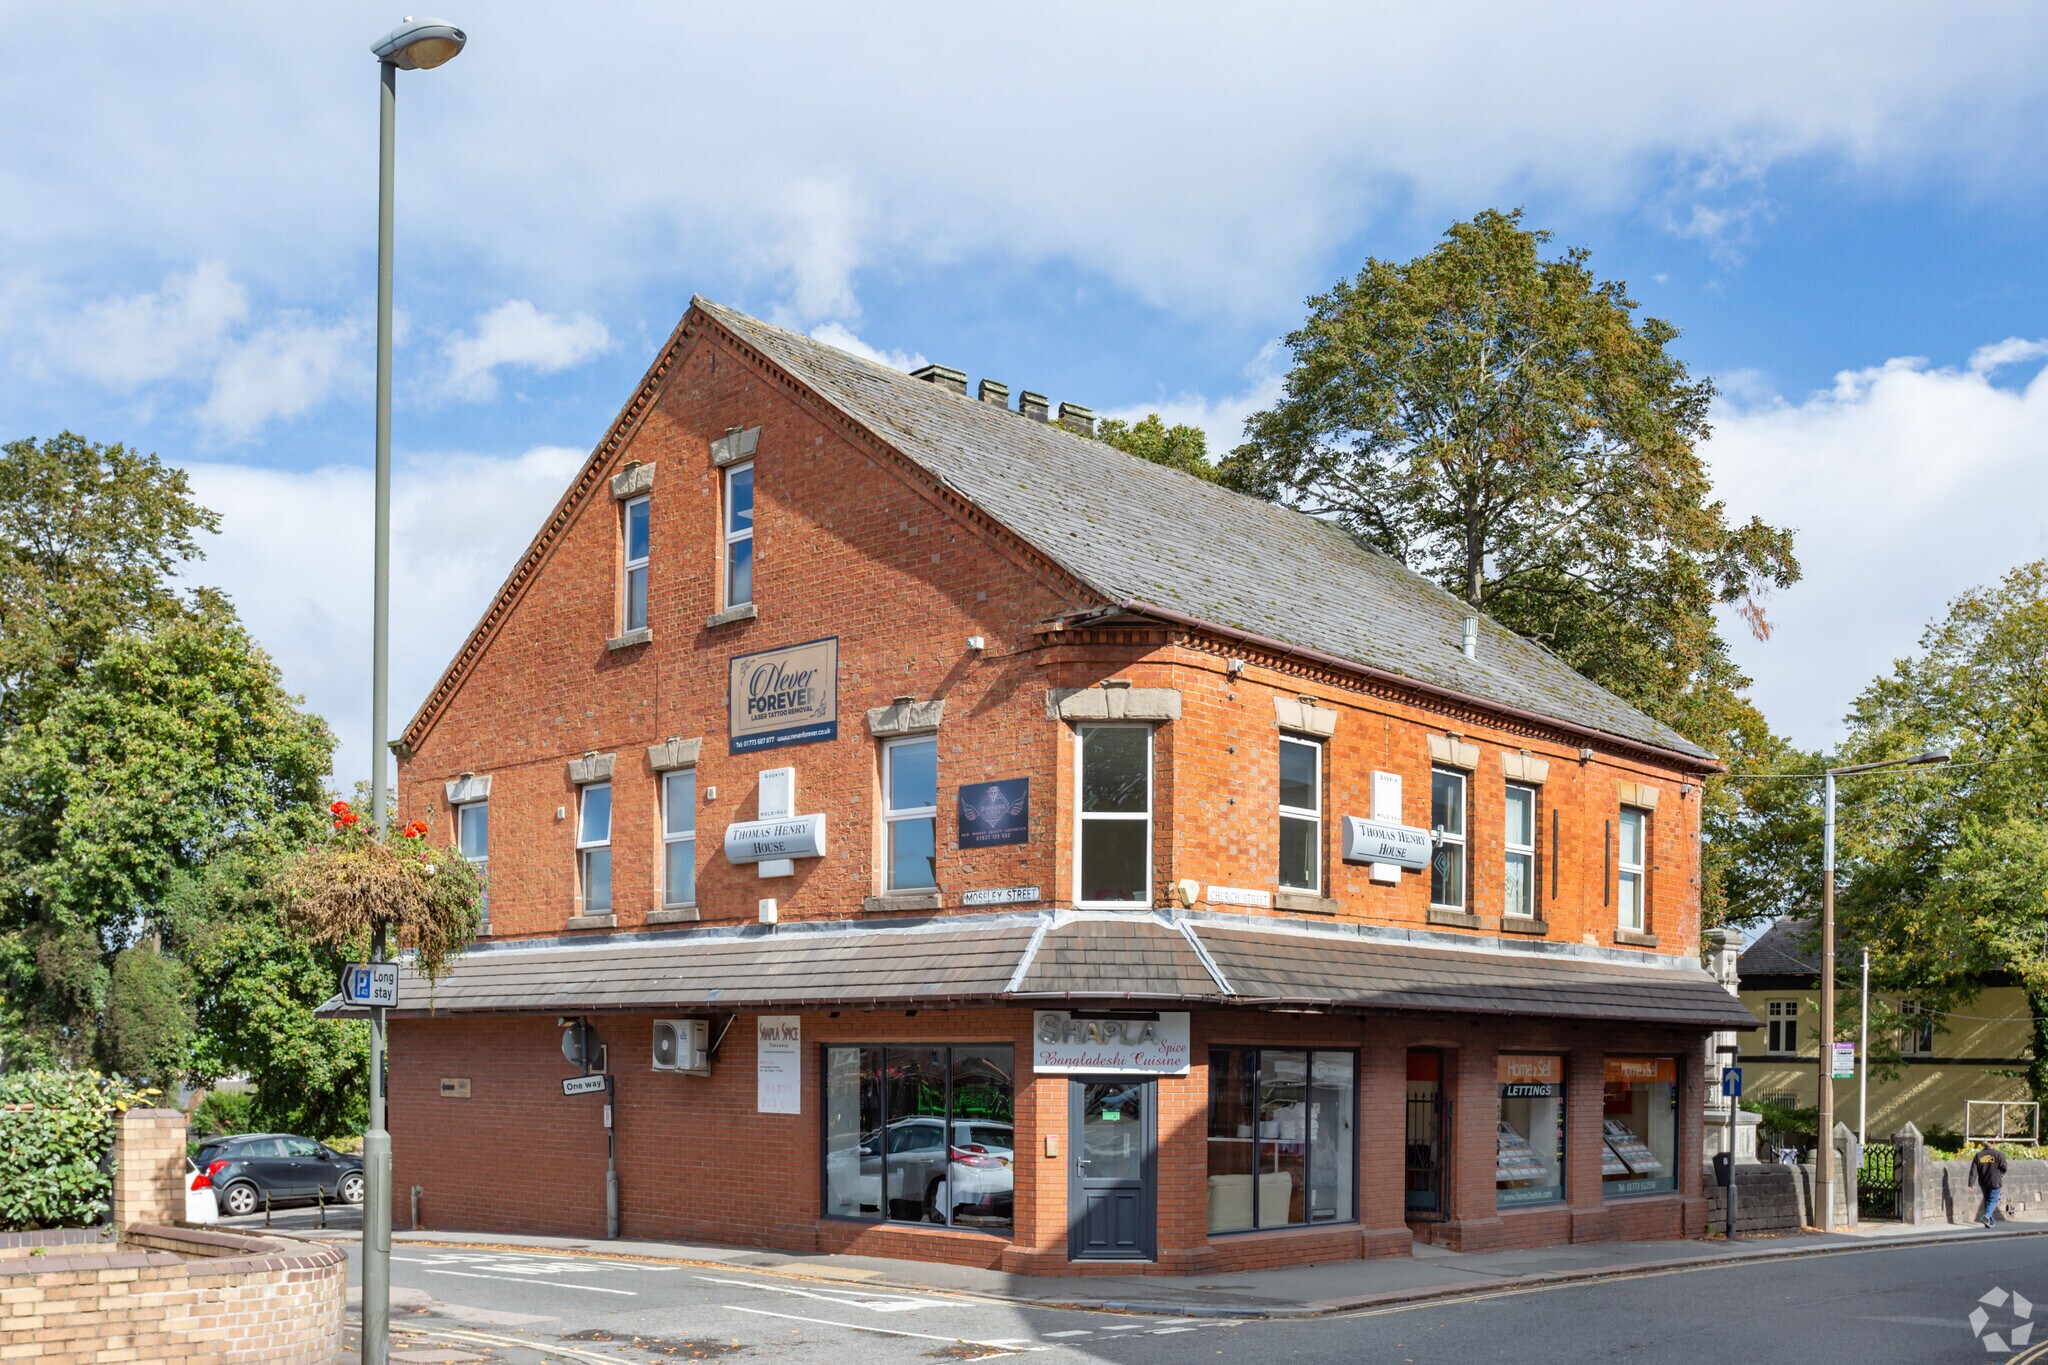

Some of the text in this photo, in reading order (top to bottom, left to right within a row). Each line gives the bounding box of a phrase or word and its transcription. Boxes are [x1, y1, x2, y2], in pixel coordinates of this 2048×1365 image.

[749, 660, 817, 696] Never
[748, 687, 815, 714] FOREVER
[751, 705, 813, 721] LASER TATTOO REMOVAL
[744, 739, 757, 747] 01773
[777, 728, 831, 742] www.neverforever.co.uk
[760, 809, 787, 817] HOLDINGS
[981, 804, 1006, 812] DIAMOND
[733, 823, 808, 840] THOMAS HENRY
[1359, 824, 1425, 846] THOMAS HENRY
[753, 841, 785, 854] HOUSE
[1379, 843, 1407, 858] HOUSE
[965, 888, 1037, 904] MOSELEY STREET
[1210, 890, 1268, 905] CHURCH STREET
[357, 972, 368, 995] P
[373, 970, 394, 985] Long
[374, 987, 392, 1001] stay
[1038, 1014, 1187, 1057] SHAPLA Spice
[1040, 1051, 1182, 1068] Bangladeshi Cuisine
[566, 1080, 602, 1091] One way
[1507, 1085, 1552, 1096] LETTINGS
[1627, 1182, 1640, 1191] 01773
